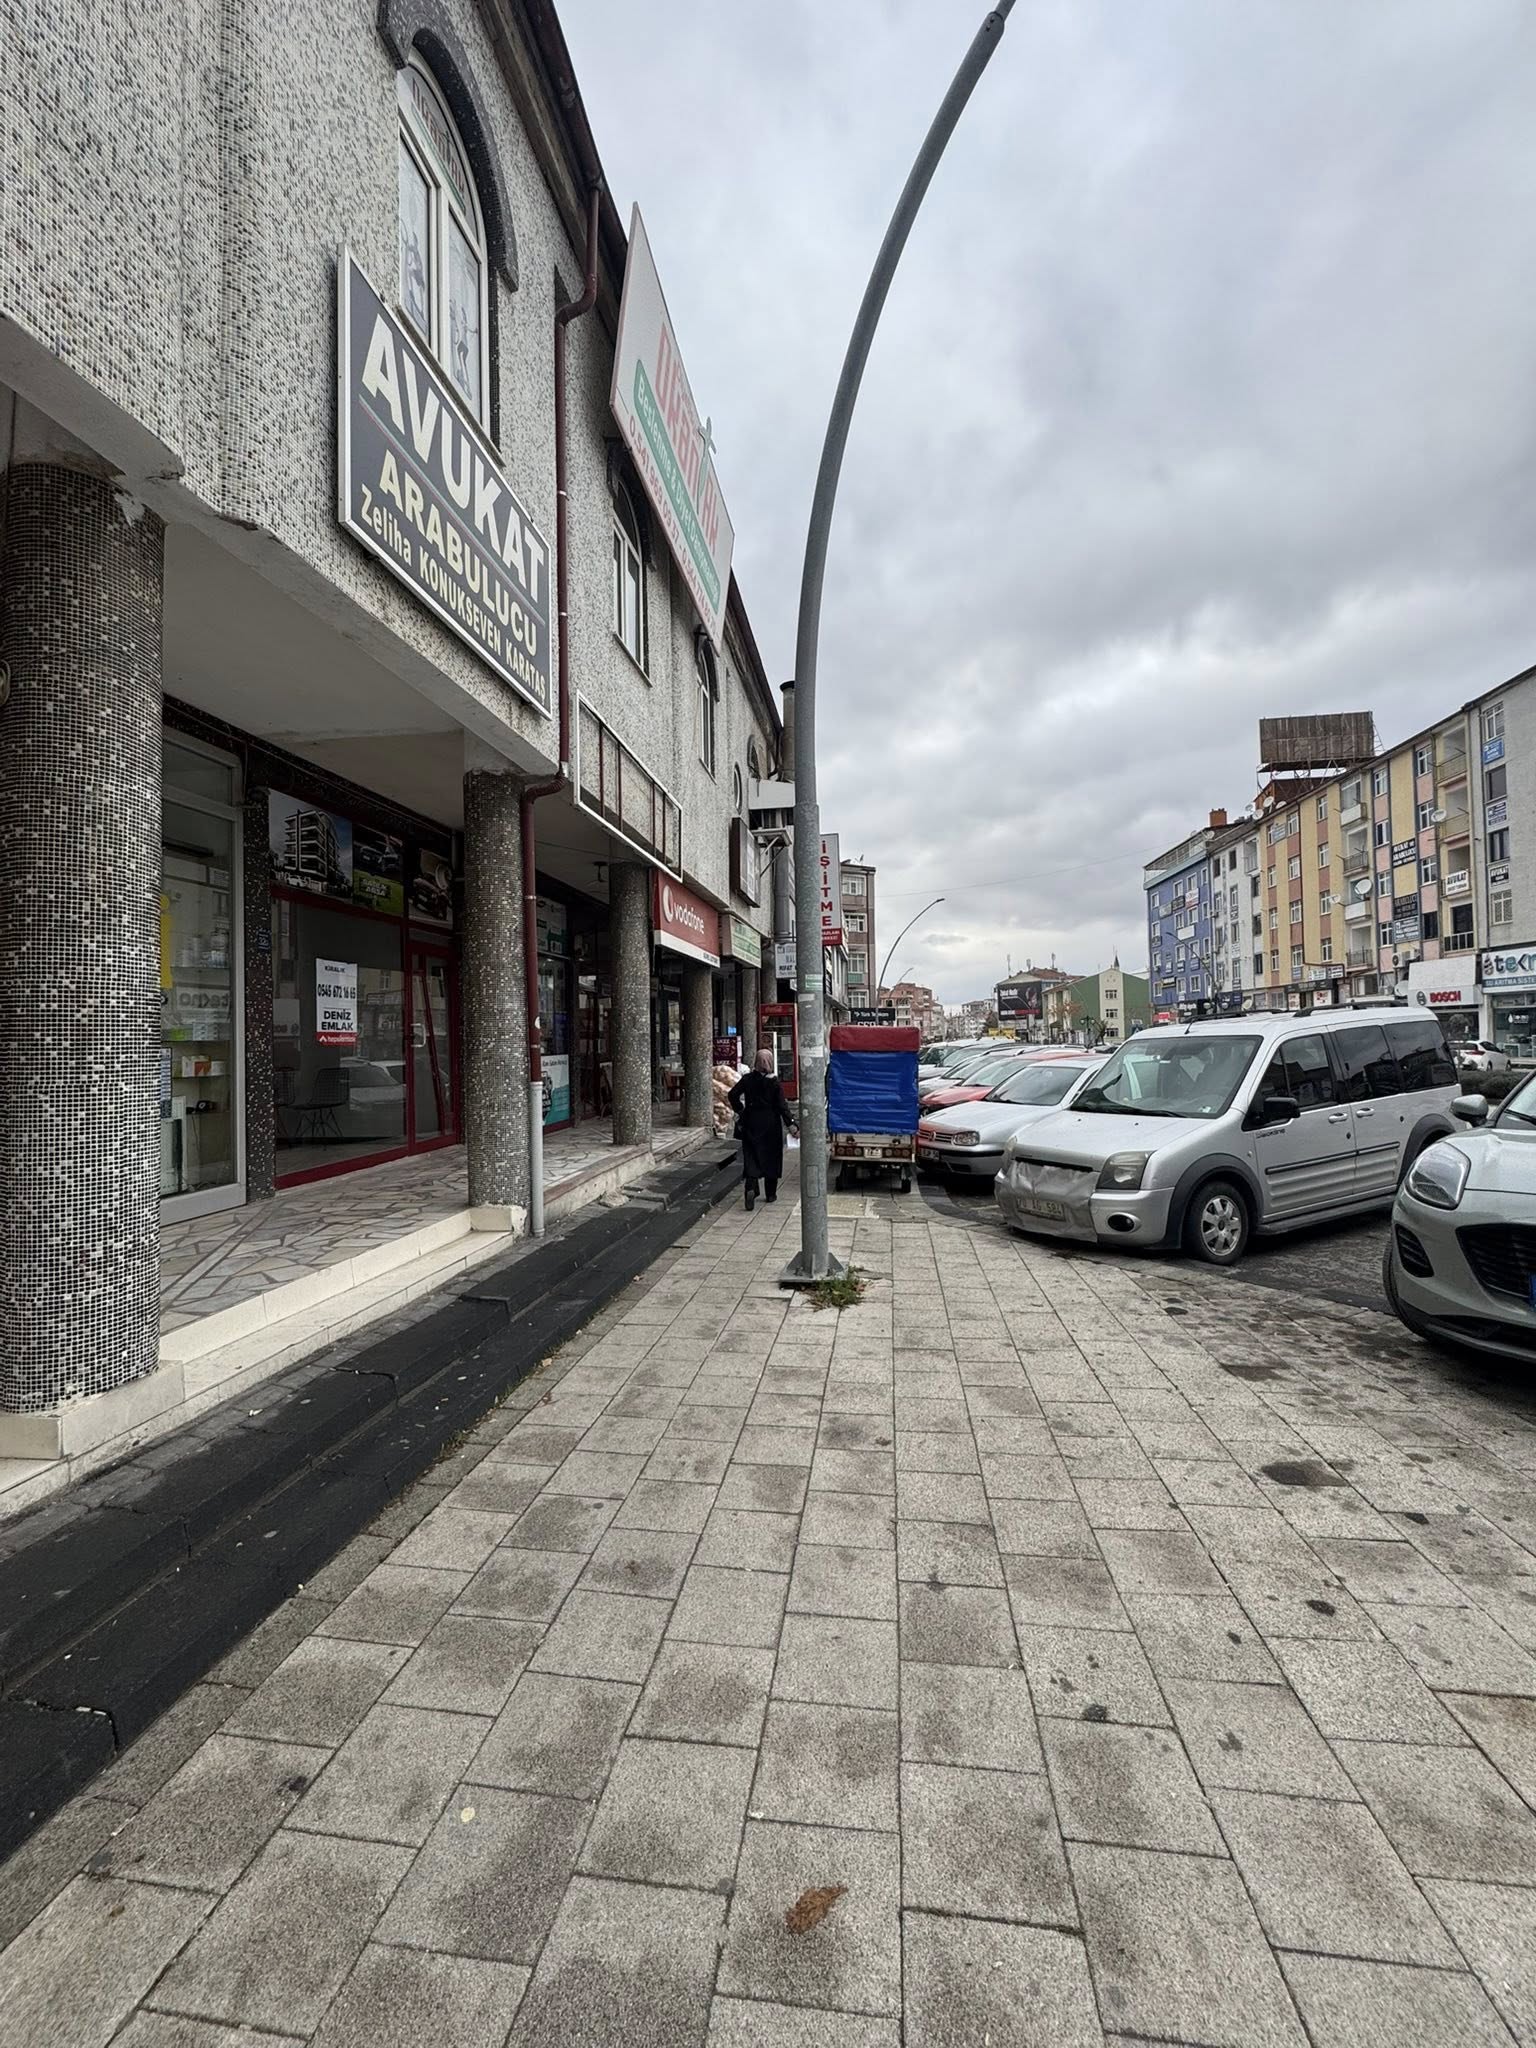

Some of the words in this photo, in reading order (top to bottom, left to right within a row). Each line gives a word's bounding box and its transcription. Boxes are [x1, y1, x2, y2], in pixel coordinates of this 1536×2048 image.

[361, 313, 545, 603] AVUKAT
[637, 371, 672, 481] Beslenme
[674, 474, 692, 539] Diyet
[379, 448, 537, 657] ARABULUCU
[361, 483, 412, 567] Zeliha
[419, 545, 501, 657] KONUKSEVEN
[506, 637, 546, 705] KARATAŞ
[820, 840, 833, 927] İŞİTME
[673, 901, 705, 935] vodafone
[317, 984, 331, 997] 0545
[323, 1009, 351, 1020] DENİZ
[1430, 991, 1461, 1002] BOSCH
[321, 1021, 354, 1031] EMLAK
